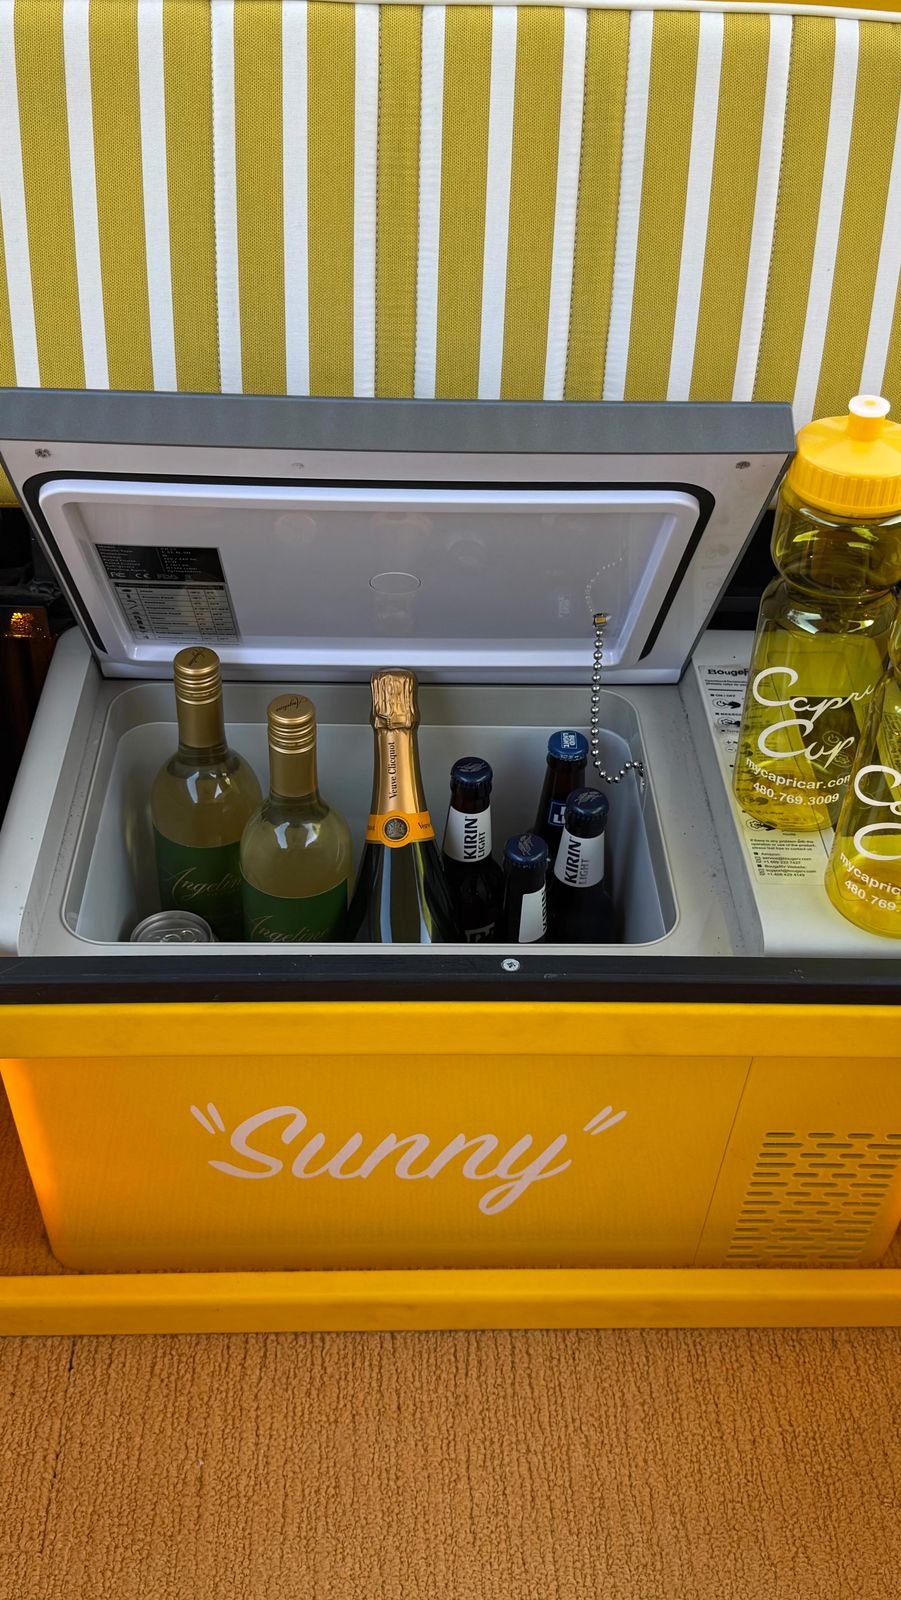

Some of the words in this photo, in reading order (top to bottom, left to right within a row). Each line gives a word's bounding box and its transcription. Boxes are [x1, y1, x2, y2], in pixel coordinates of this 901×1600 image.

[752, 666, 874, 722] Capri
[387, 741, 398, 775] Clicquot
[757, 718, 855, 769] Cup
[388, 776, 398, 799] Veuve
[752, 782, 840, 806] 480.769.3009
[463, 816, 479, 860] KIRIN
[477, 831, 486, 859] LIGHT
[564, 838, 582, 884] KIRIN
[578, 858, 591, 885] LIGHT
